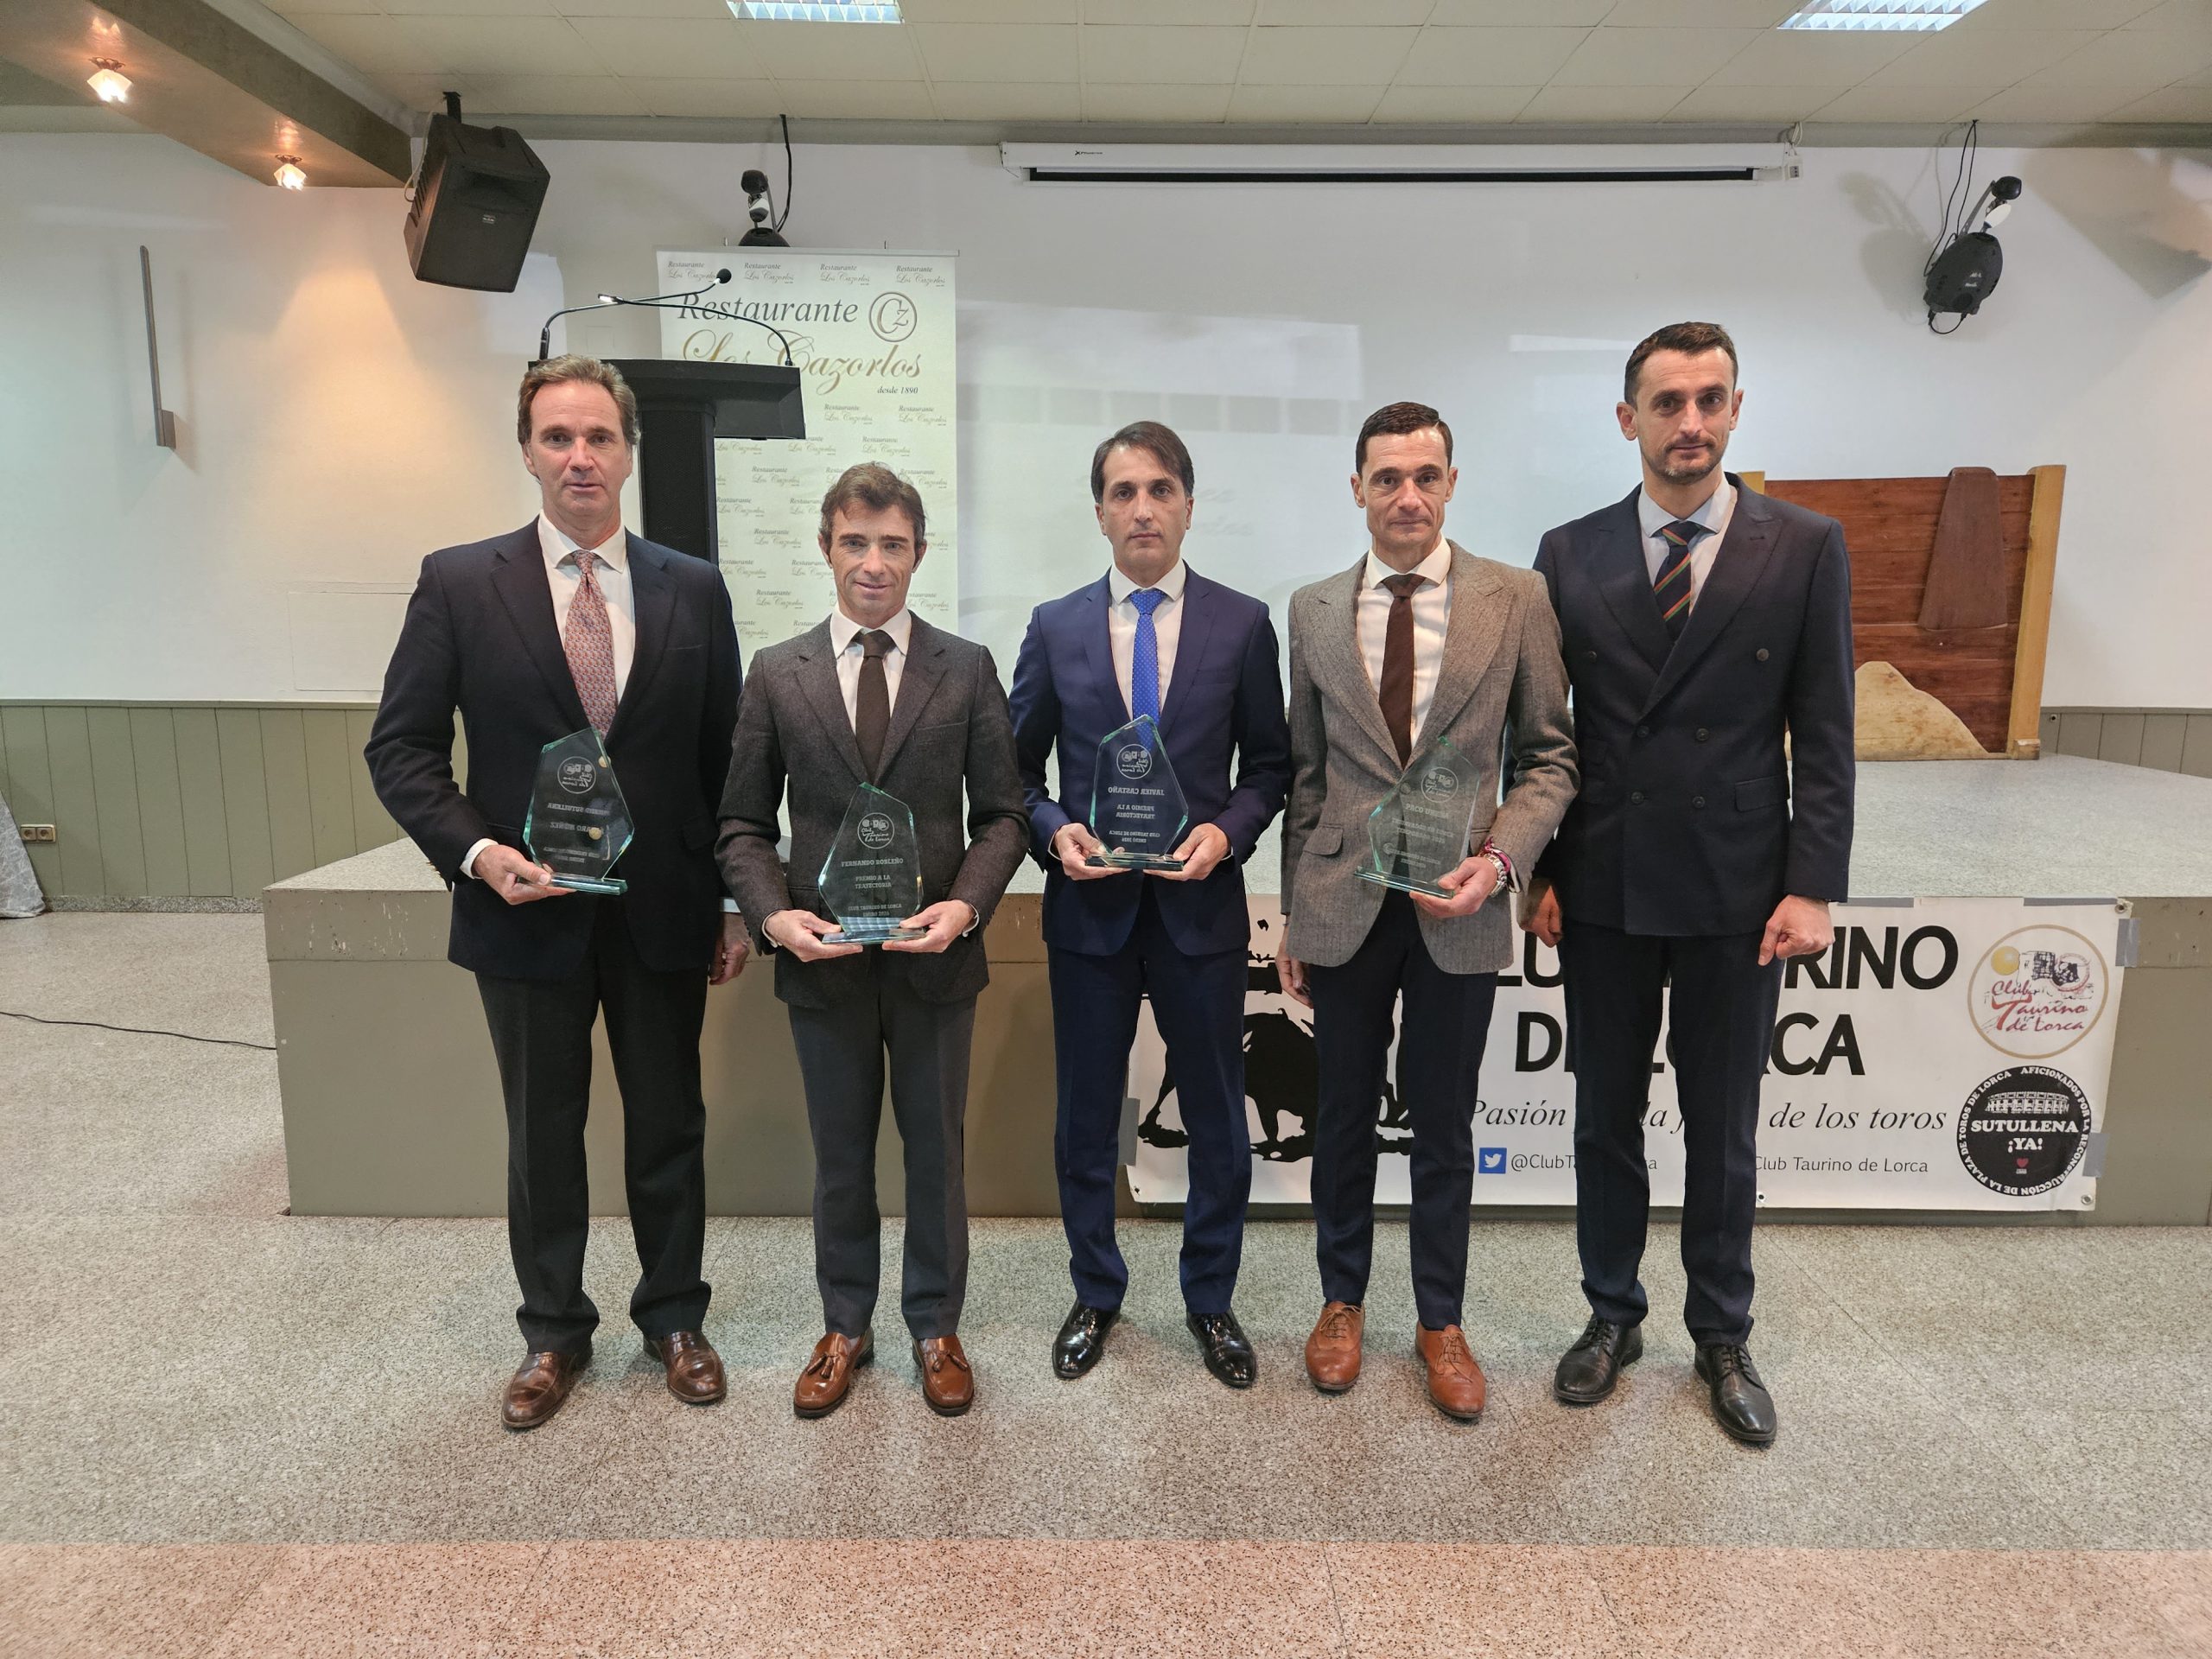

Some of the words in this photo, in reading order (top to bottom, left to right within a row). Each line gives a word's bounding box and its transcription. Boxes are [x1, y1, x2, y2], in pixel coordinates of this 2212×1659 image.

[677, 292, 858, 322] Restaurante
[767, 329, 921, 396] Cazorlos
[877, 385, 898, 394] desde
[1784, 925, 1959, 989] RINO
[1992, 980, 2031, 995] Club
[1992, 995, 2088, 1031] Taurino
[2005, 1019, 2028, 1032] de
[2034, 1016, 2085, 1032] Lorca
[1979, 1071, 2012, 1092] LORCA
[2020, 1066, 2082, 1098] AFICIONADOS
[1967, 1092, 1980, 1106] DE
[2077, 1096, 2089, 1119] POR
[1769, 1102, 1805, 1128] de
[1815, 1103, 1859, 1129] los
[1869, 1108, 1947, 1129] toros
[1959, 1106, 1972, 1141] TOROS
[1971, 1120, 2079, 1133] SUTULLENA
[2082, 1119, 2091, 1132] LA
[1959, 1141, 1968, 1156] DE
[2007, 1137, 2043, 1153] ¡YA!
[1756, 1156, 1787, 1170] Club
[1793, 1156, 1853, 1172] Taurino
[1859, 1158, 1878, 1173] de
[1885, 1158, 1929, 1173] Lorca
[1964, 1155, 1988, 1184] PLAZA
[2020, 1133, 2088, 1196] RECONSTRUCCIÓN
[1989, 1179, 2001, 1191] LA
[2004, 1186, 2018, 1195] DE
